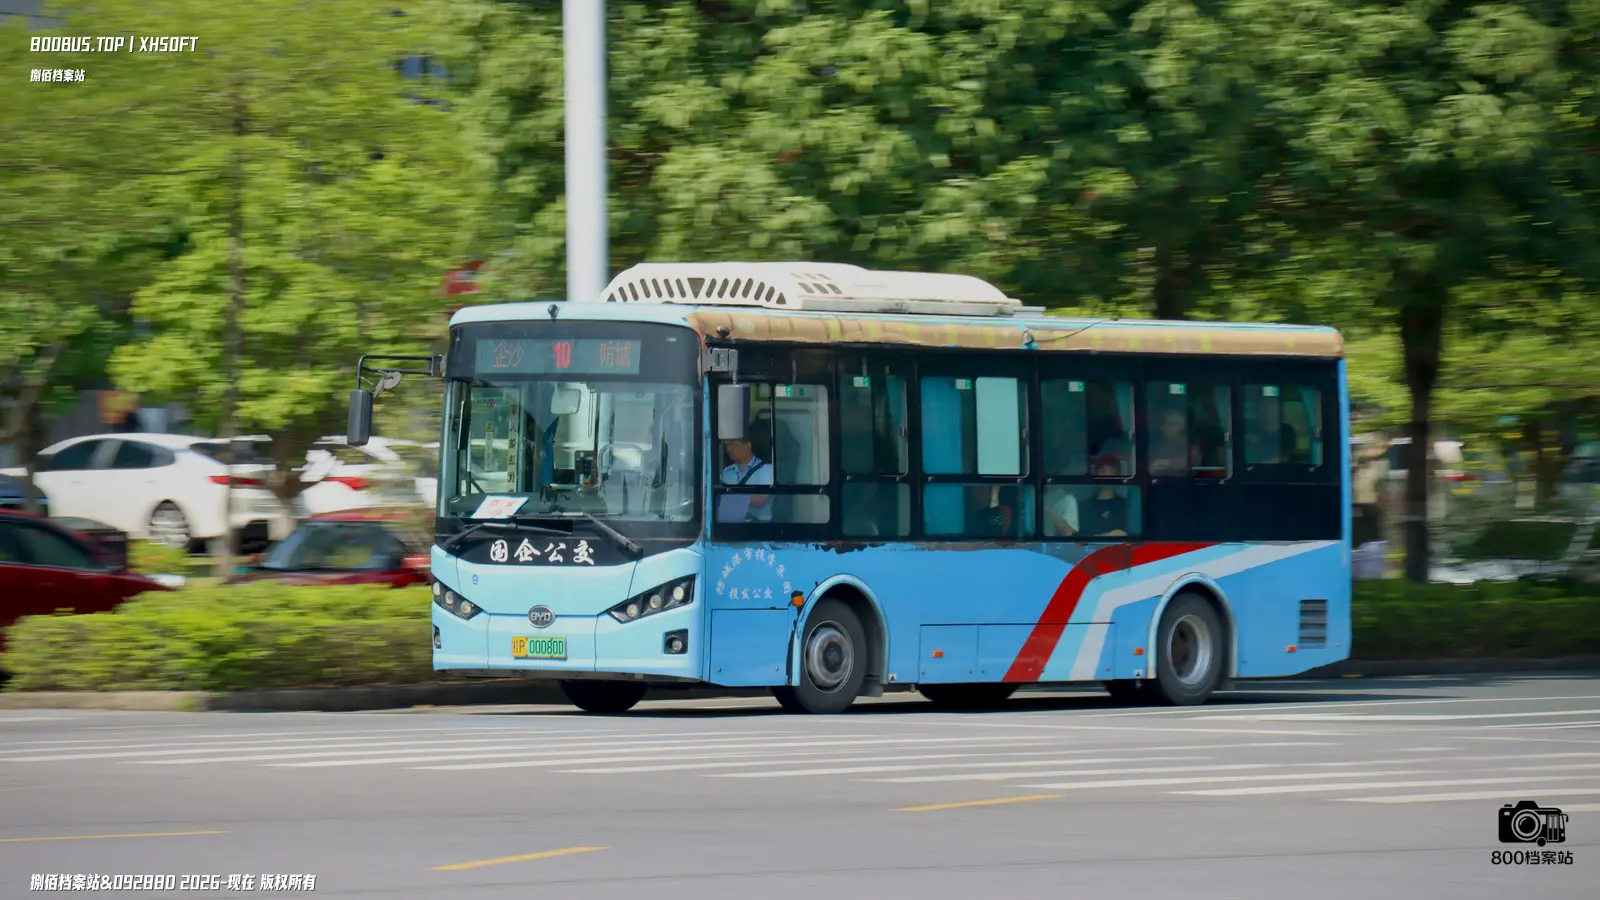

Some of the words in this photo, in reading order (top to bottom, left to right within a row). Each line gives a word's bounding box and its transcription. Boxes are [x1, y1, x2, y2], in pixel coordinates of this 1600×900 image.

[492, 340, 524, 368] 企沙
[553, 341, 571, 369] 10
[599, 341, 631, 368] 防城
[490, 538, 595, 565] 国企公交
[530, 612, 551, 621] BYD
